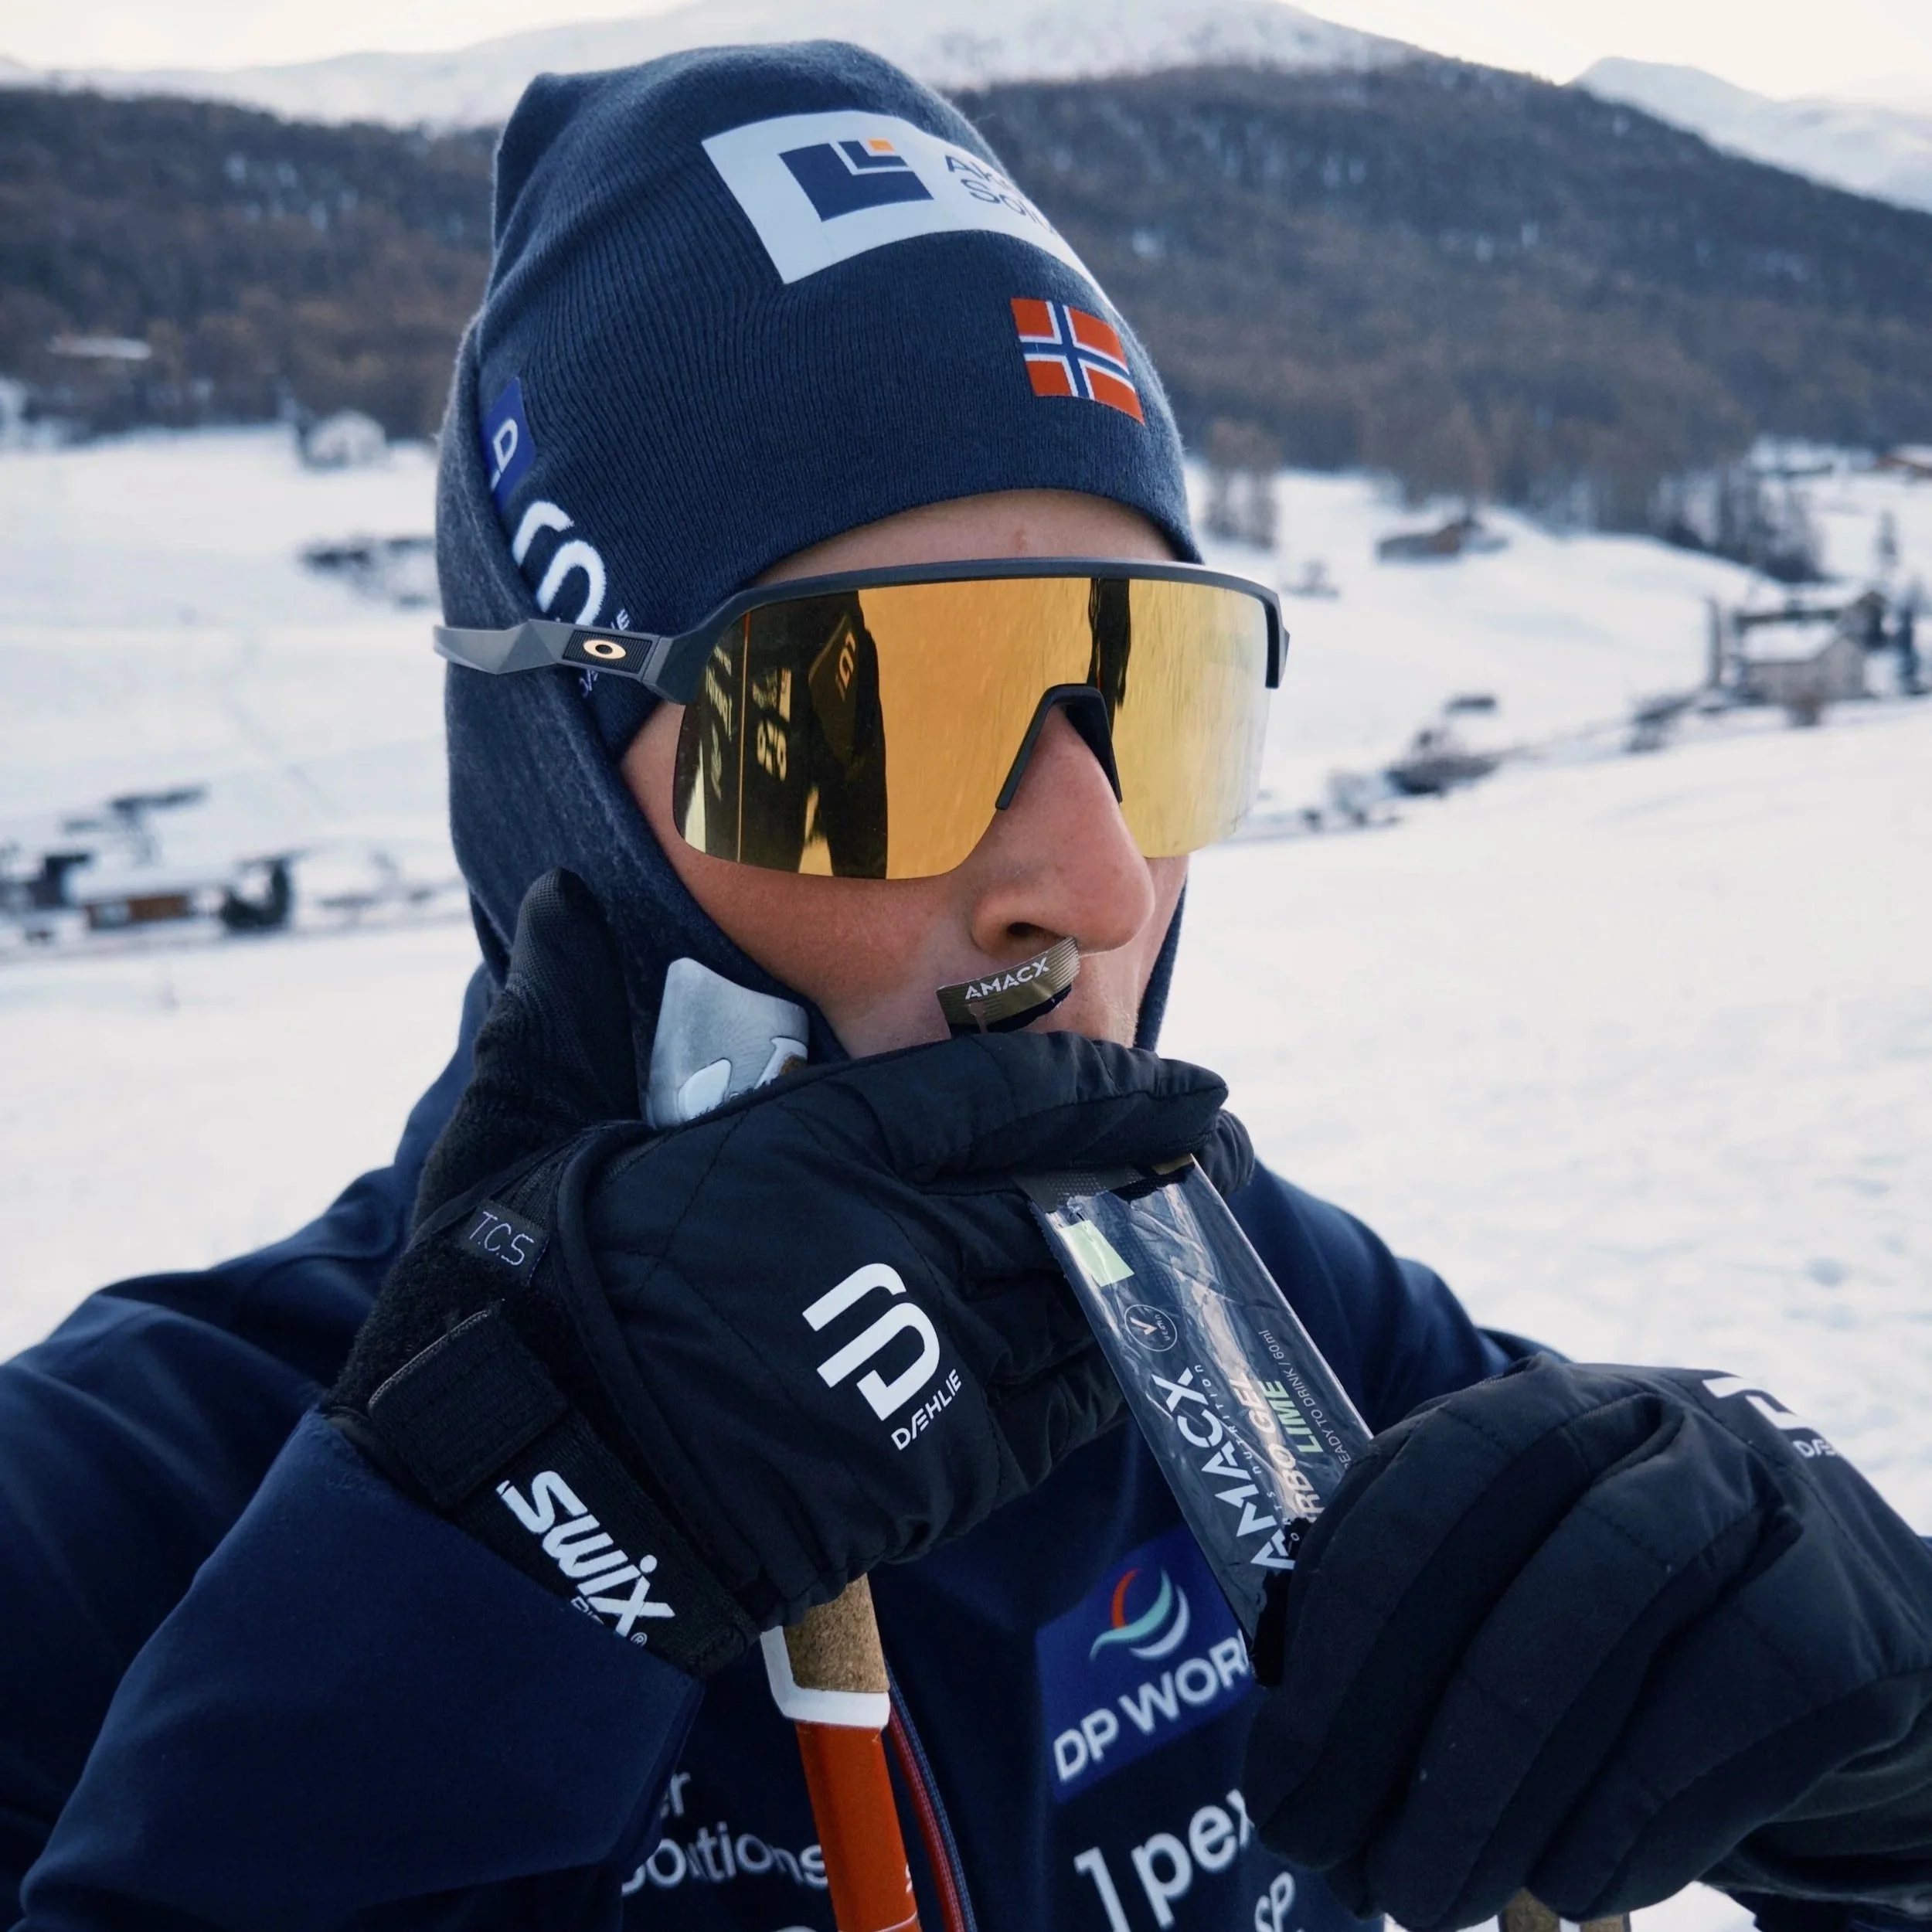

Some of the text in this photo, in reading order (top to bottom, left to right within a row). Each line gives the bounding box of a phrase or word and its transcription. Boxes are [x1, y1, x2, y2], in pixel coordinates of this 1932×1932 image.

[964, 957, 1050, 1000] AMACX
[1229, 1372, 1275, 1434] GEL
[1257, 1380, 1324, 1453] LIME
[1283, 1367, 1316, 1406] DRINK
[1311, 1410, 1329, 1427] TO
[1151, 1367, 1296, 1570] AMACX
[1052, 1628, 1250, 1784] DP WOR
